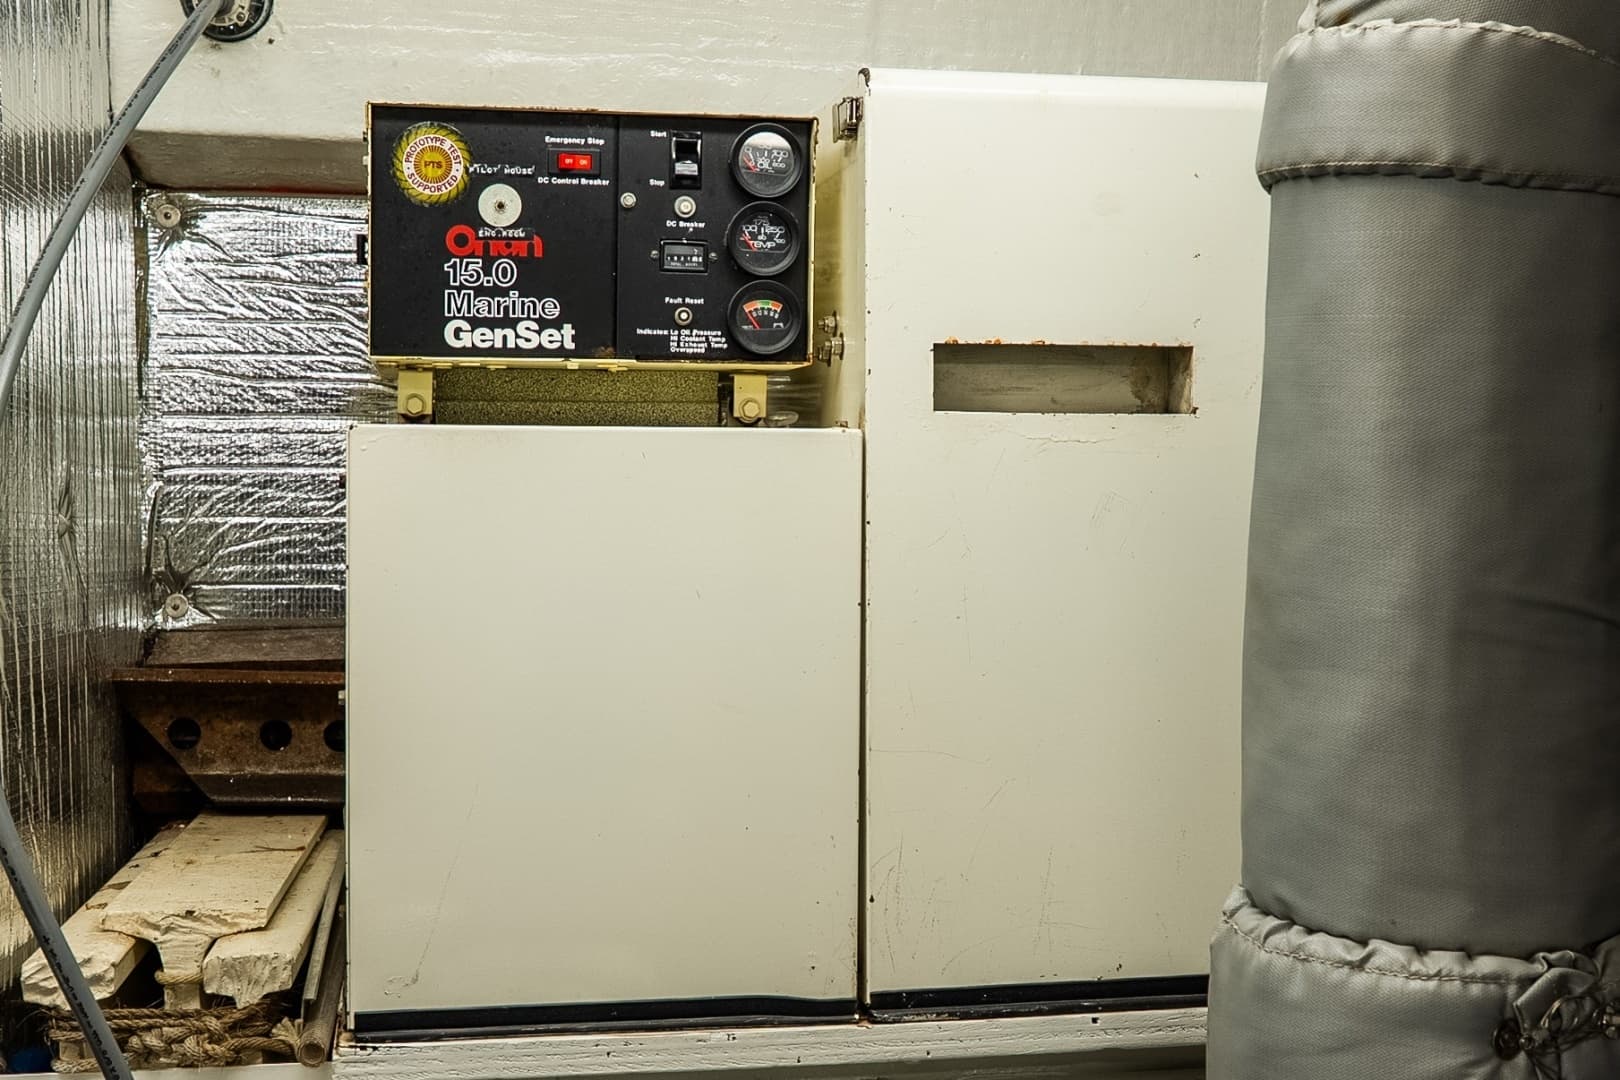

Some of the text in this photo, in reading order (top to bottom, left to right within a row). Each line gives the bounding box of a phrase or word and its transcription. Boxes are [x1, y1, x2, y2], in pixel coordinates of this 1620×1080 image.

[650, 130, 667, 138] Start
[544, 135, 605, 146] Emergency Stop
[404, 136, 462, 165] PROTOTYPE TEST
[424, 160, 444, 169] PTS
[407, 172, 459, 193] SUPPORTED
[537, 176, 610, 186] DC Control Breaker
[649, 178, 665, 187] Stop
[666, 219, 706, 229] DC Breaker
[444, 258, 517, 287] 15.0
[444, 289, 561, 319] Marine
[664, 296, 705, 305] Fault Reset
[443, 319, 576, 350] GenSet
